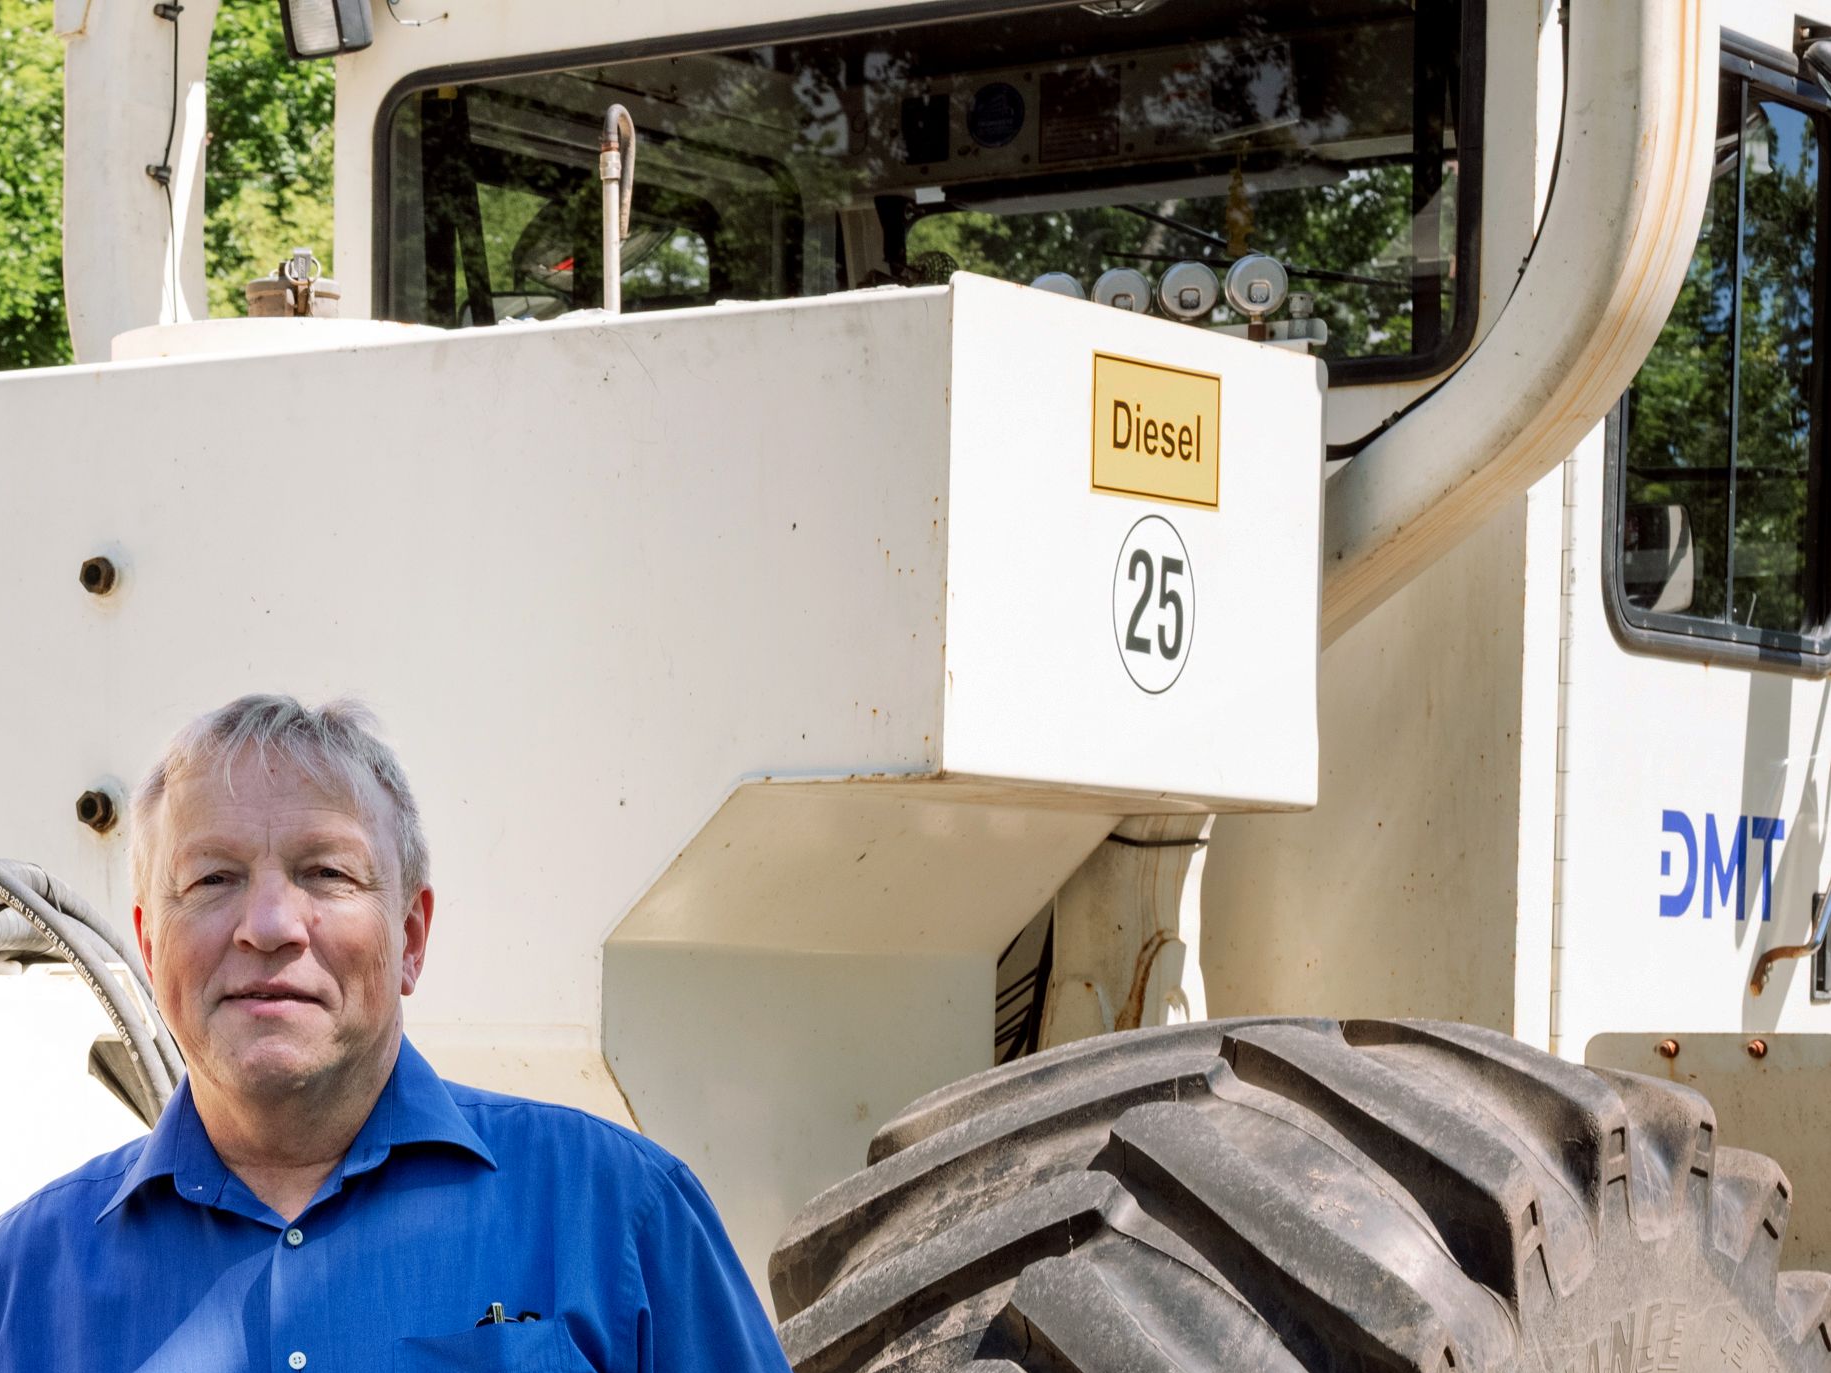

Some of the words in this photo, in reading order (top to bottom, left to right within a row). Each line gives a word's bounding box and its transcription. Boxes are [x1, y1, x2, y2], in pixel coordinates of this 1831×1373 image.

[1112, 398, 1202, 463] Diesel
[1125, 548, 1184, 661] 25
[1659, 809, 1785, 922] DMT
[10, 896, 25, 914] 2SN
[25, 906, 34, 921] 12
[33, 915, 47, 931] WP
[46, 927, 59, 944] 275
[58, 940, 76, 963] BAR
[74, 959, 95, 986] MSHA
